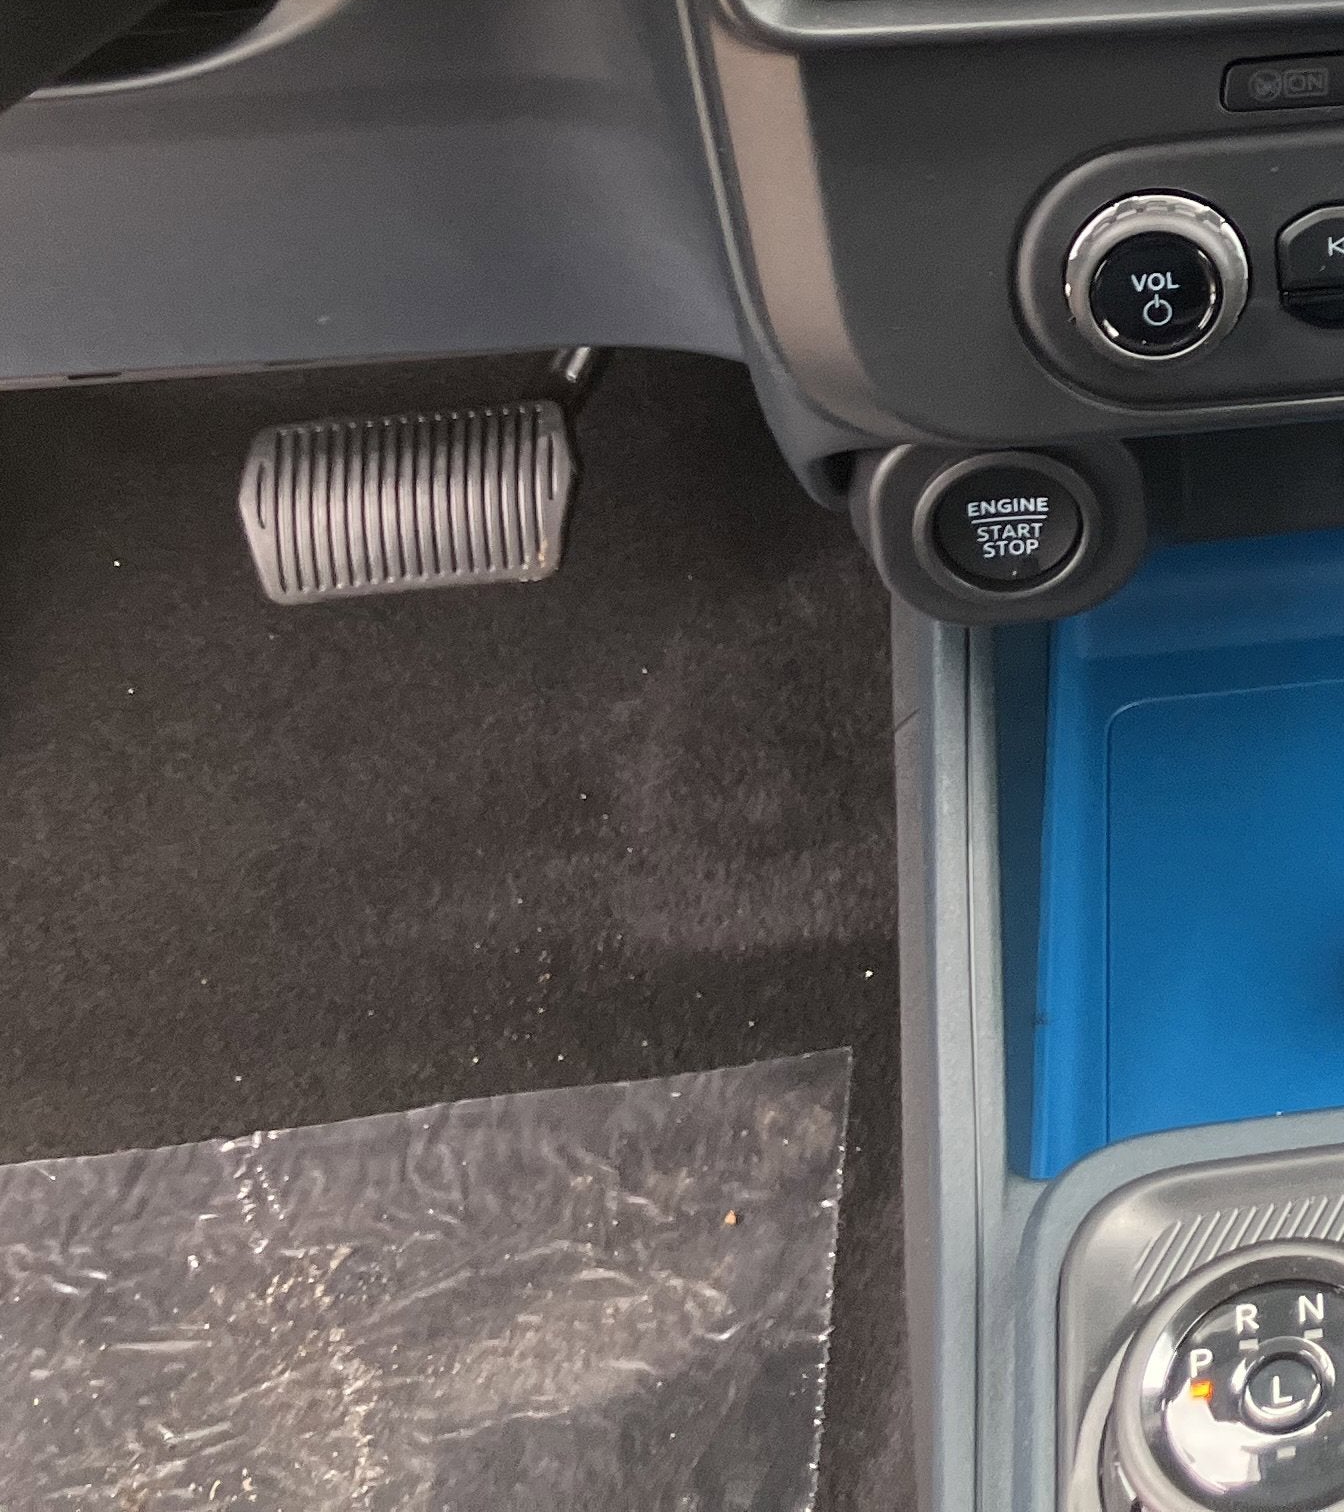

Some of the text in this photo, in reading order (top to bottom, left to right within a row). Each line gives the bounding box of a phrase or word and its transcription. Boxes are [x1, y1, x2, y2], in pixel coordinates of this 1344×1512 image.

[1130, 271, 1181, 293] VOL
[967, 497, 1050, 517] ENGINE
[976, 522, 1043, 542] START
[982, 538, 1039, 558] STOP
[1189, 1347, 1214, 1378] P
[1235, 1303, 1261, 1334] R
[1298, 1292, 1326, 1322] N
[1271, 1375, 1293, 1405] L
